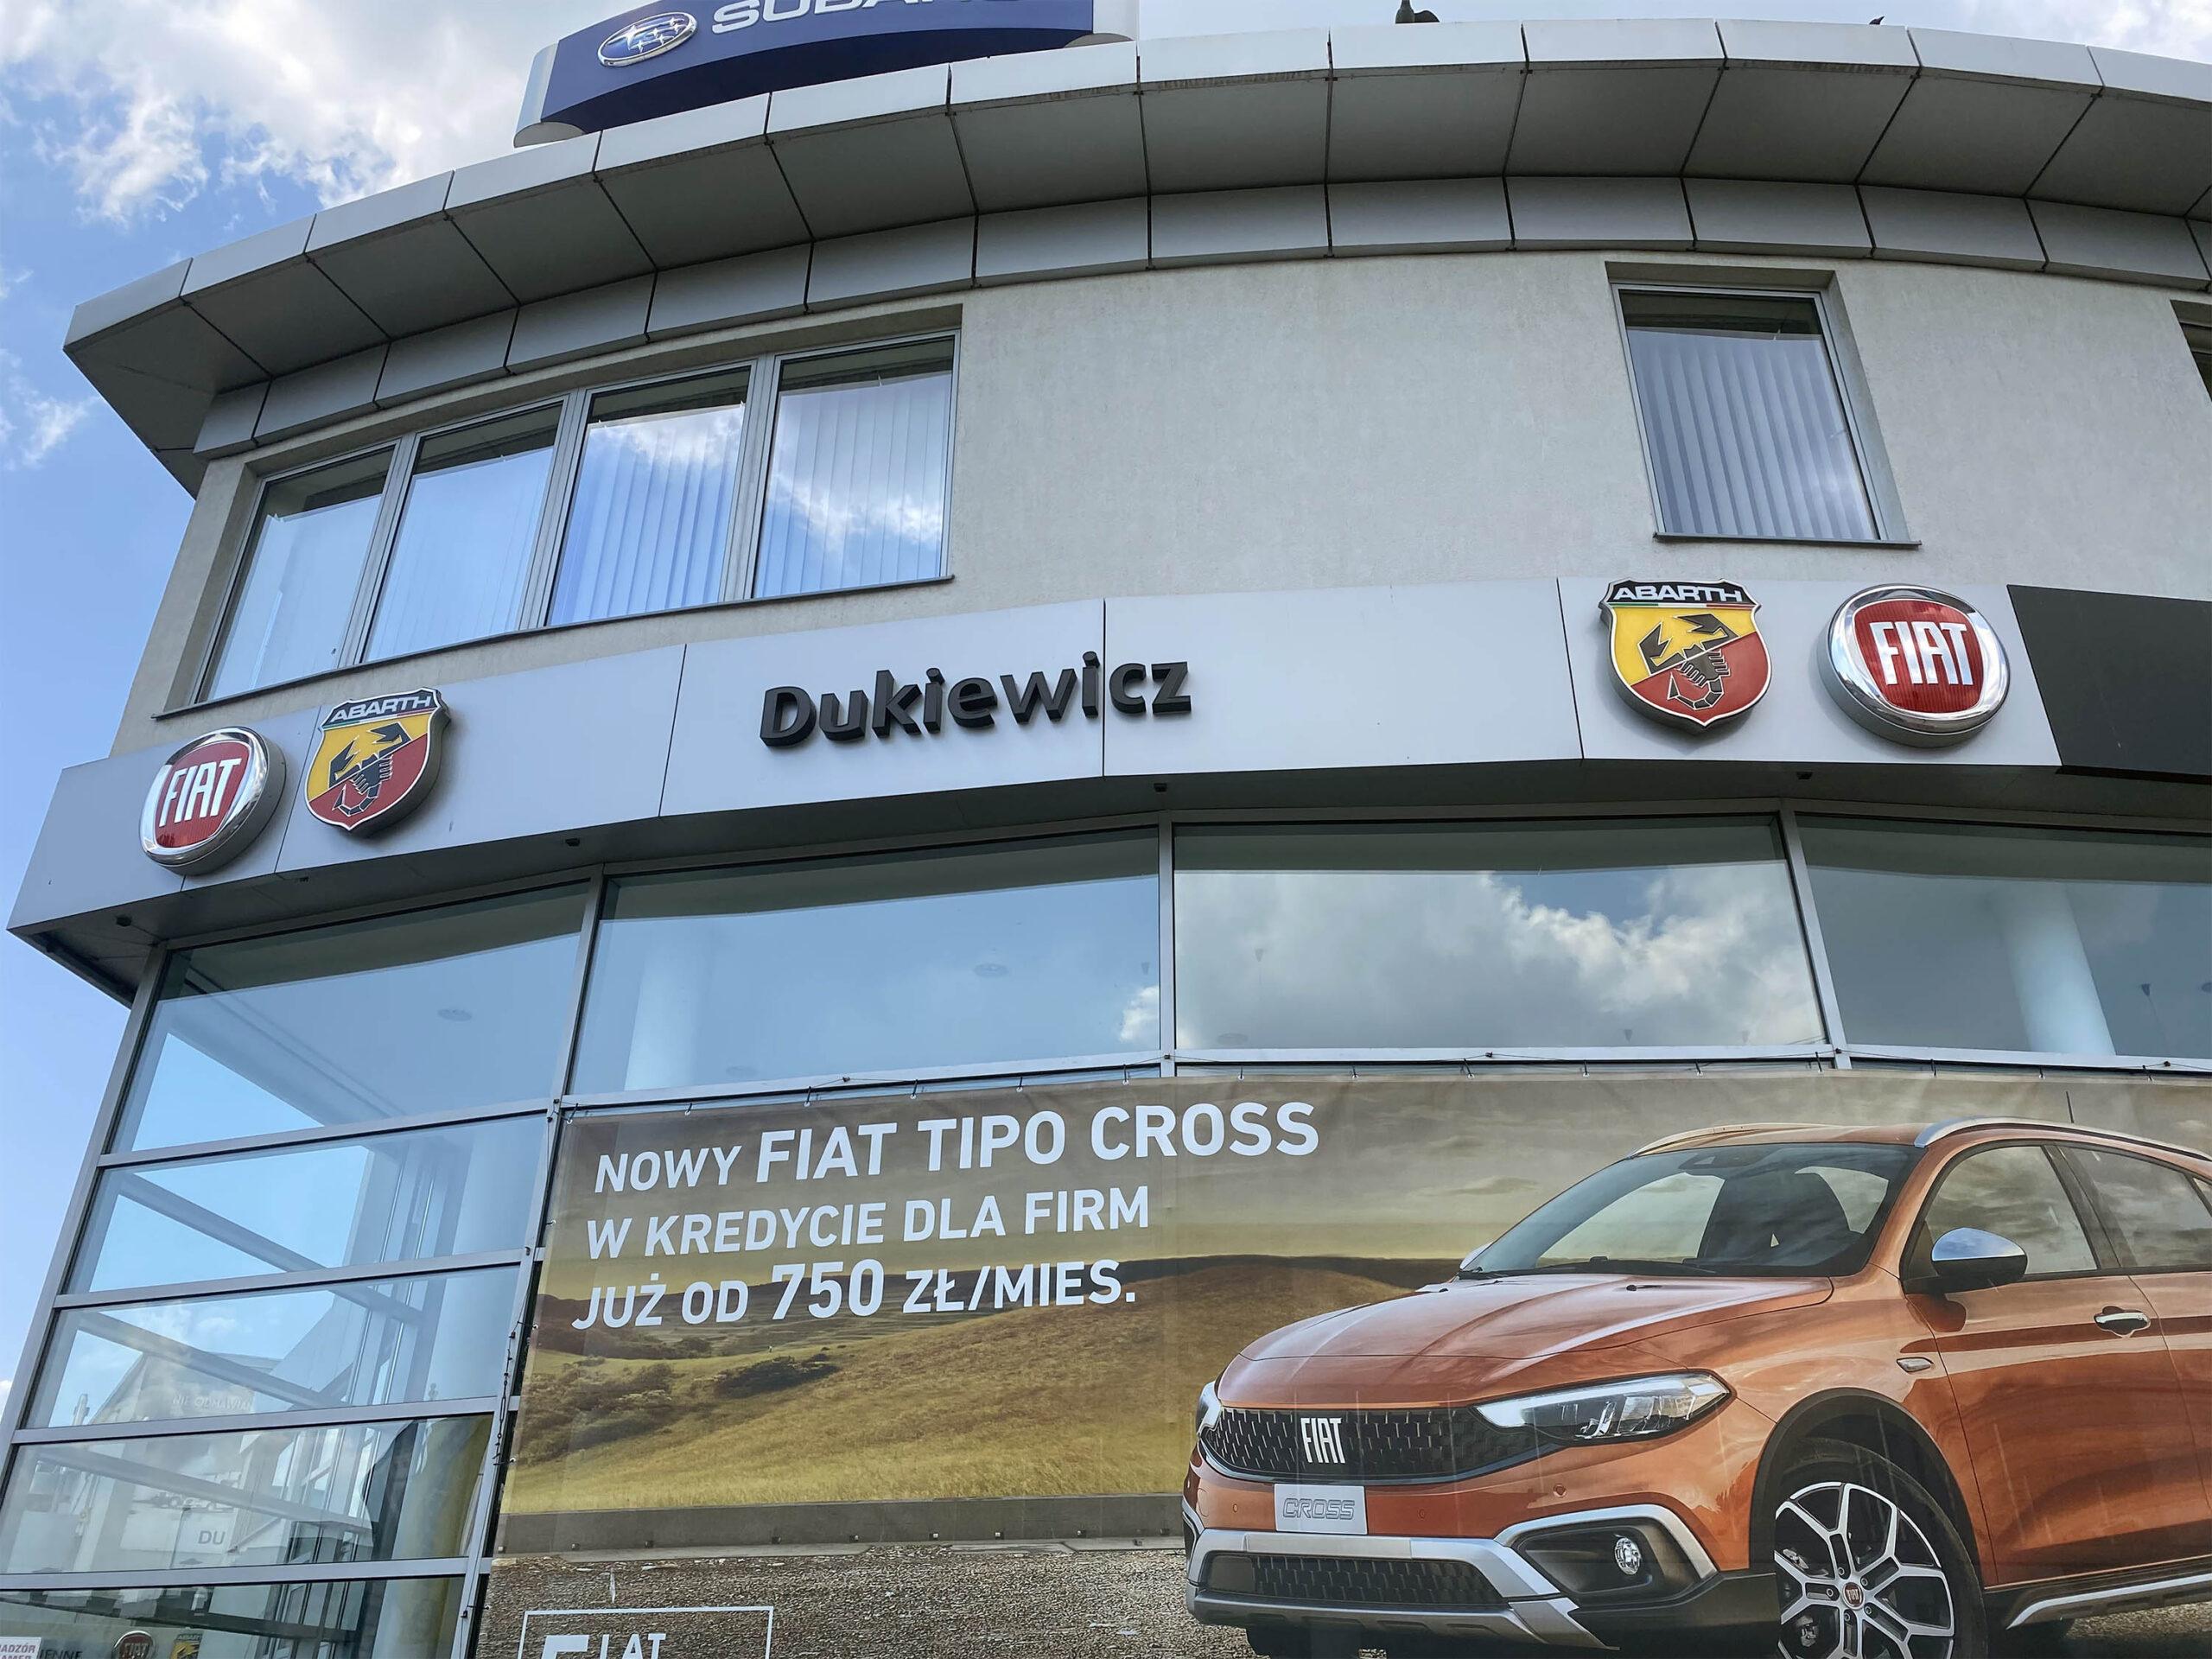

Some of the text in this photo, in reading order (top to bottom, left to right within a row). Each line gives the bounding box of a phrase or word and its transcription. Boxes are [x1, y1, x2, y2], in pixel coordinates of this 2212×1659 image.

[1612, 584, 1743, 603] ABARTH
[1869, 621, 1974, 686] FIAT
[330, 696, 432, 723] ABARTH
[759, 651, 1192, 747] Dukiewicz
[158, 757, 242, 829] FIAT
[594, 1102, 1319, 1193] NOWY FIAT TIPO CROSS
[587, 1185, 1149, 1260] W KREDYCIE DLA FIRM
[571, 1258, 1136, 1331] JUŻ OD 750 ZŁ/MIES.
[1300, 1418, 1346, 1464] FIAT
[1282, 1497, 1356, 1520] CROSS
[0, 1643, 35, 1653] ADZÓR
